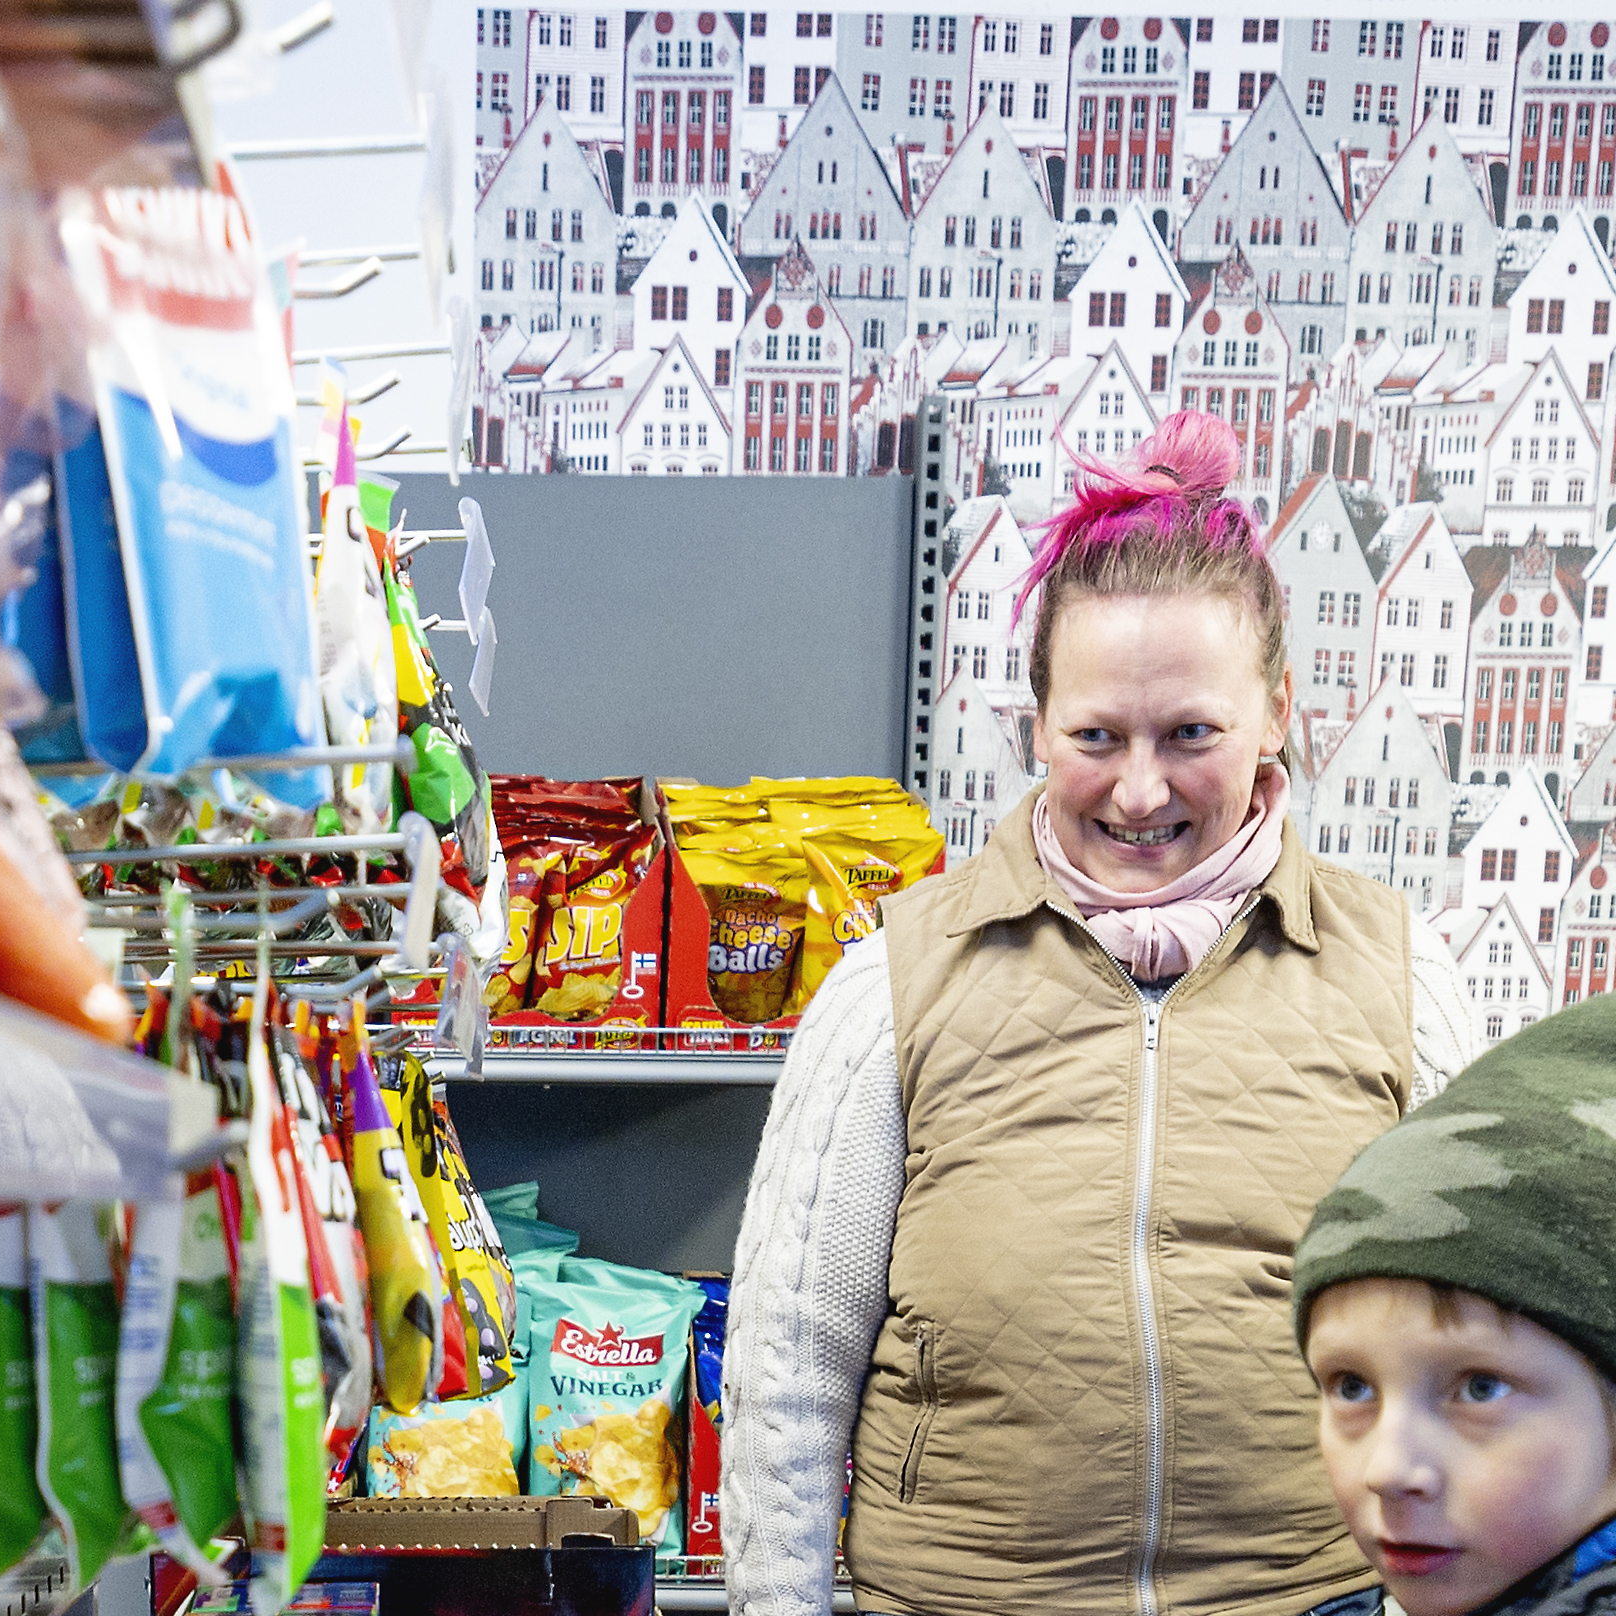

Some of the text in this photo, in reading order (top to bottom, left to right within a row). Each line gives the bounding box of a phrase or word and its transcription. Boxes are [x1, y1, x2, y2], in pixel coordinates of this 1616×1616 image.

[546, 903, 621, 965] SIP
[708, 944, 785, 973] Balls
[560, 1329, 657, 1364] Estrella
[550, 1376, 663, 1397] VINEGAR
[576, 1367, 623, 1382] SALT
